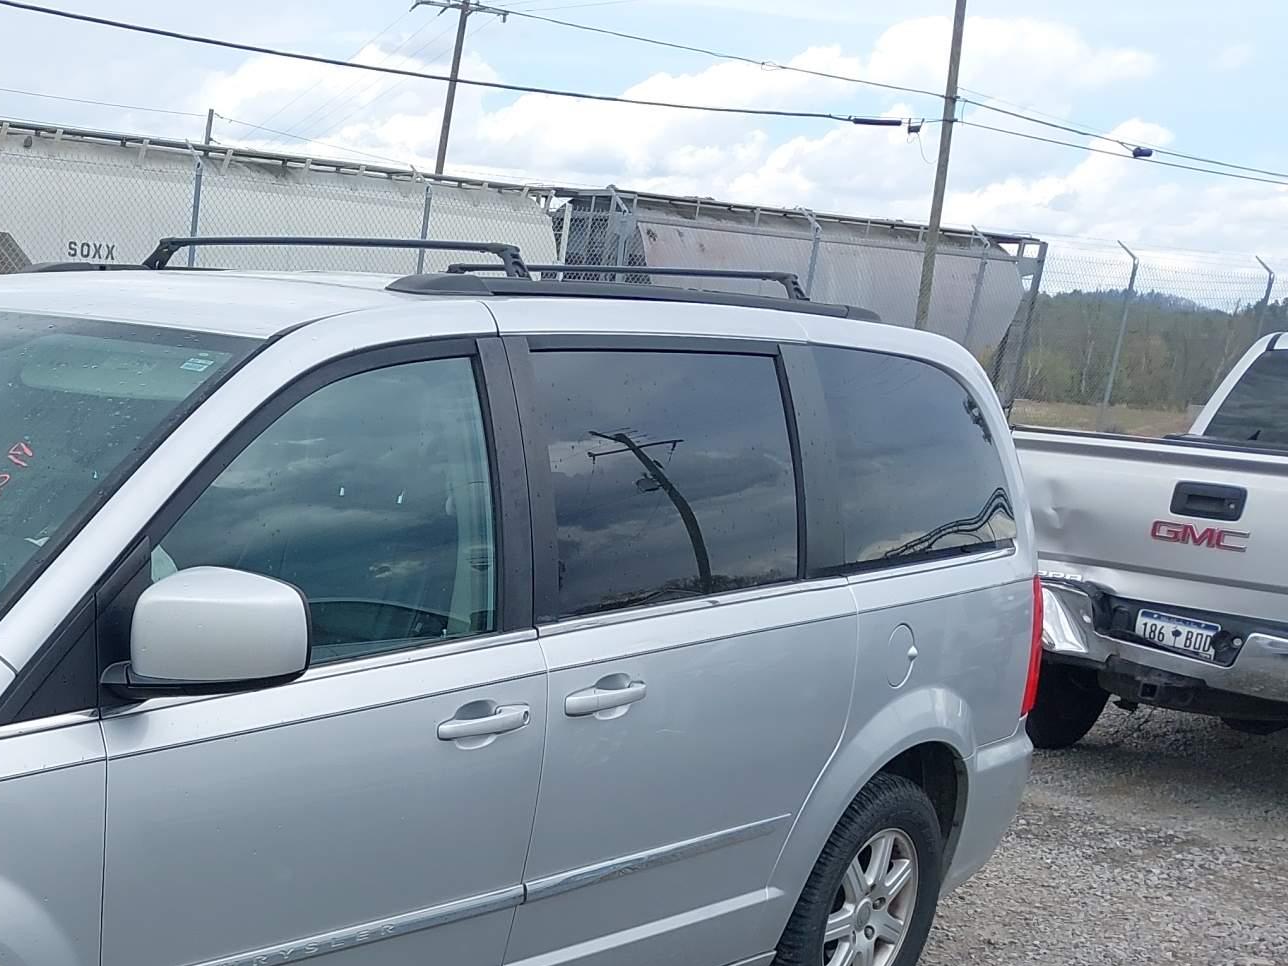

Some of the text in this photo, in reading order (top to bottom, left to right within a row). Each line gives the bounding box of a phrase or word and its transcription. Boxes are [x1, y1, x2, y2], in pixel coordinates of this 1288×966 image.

[68, 241, 115, 260] SOXX
[1151, 520, 1250, 552] GMC
[1142, 622, 1165, 642] 186
